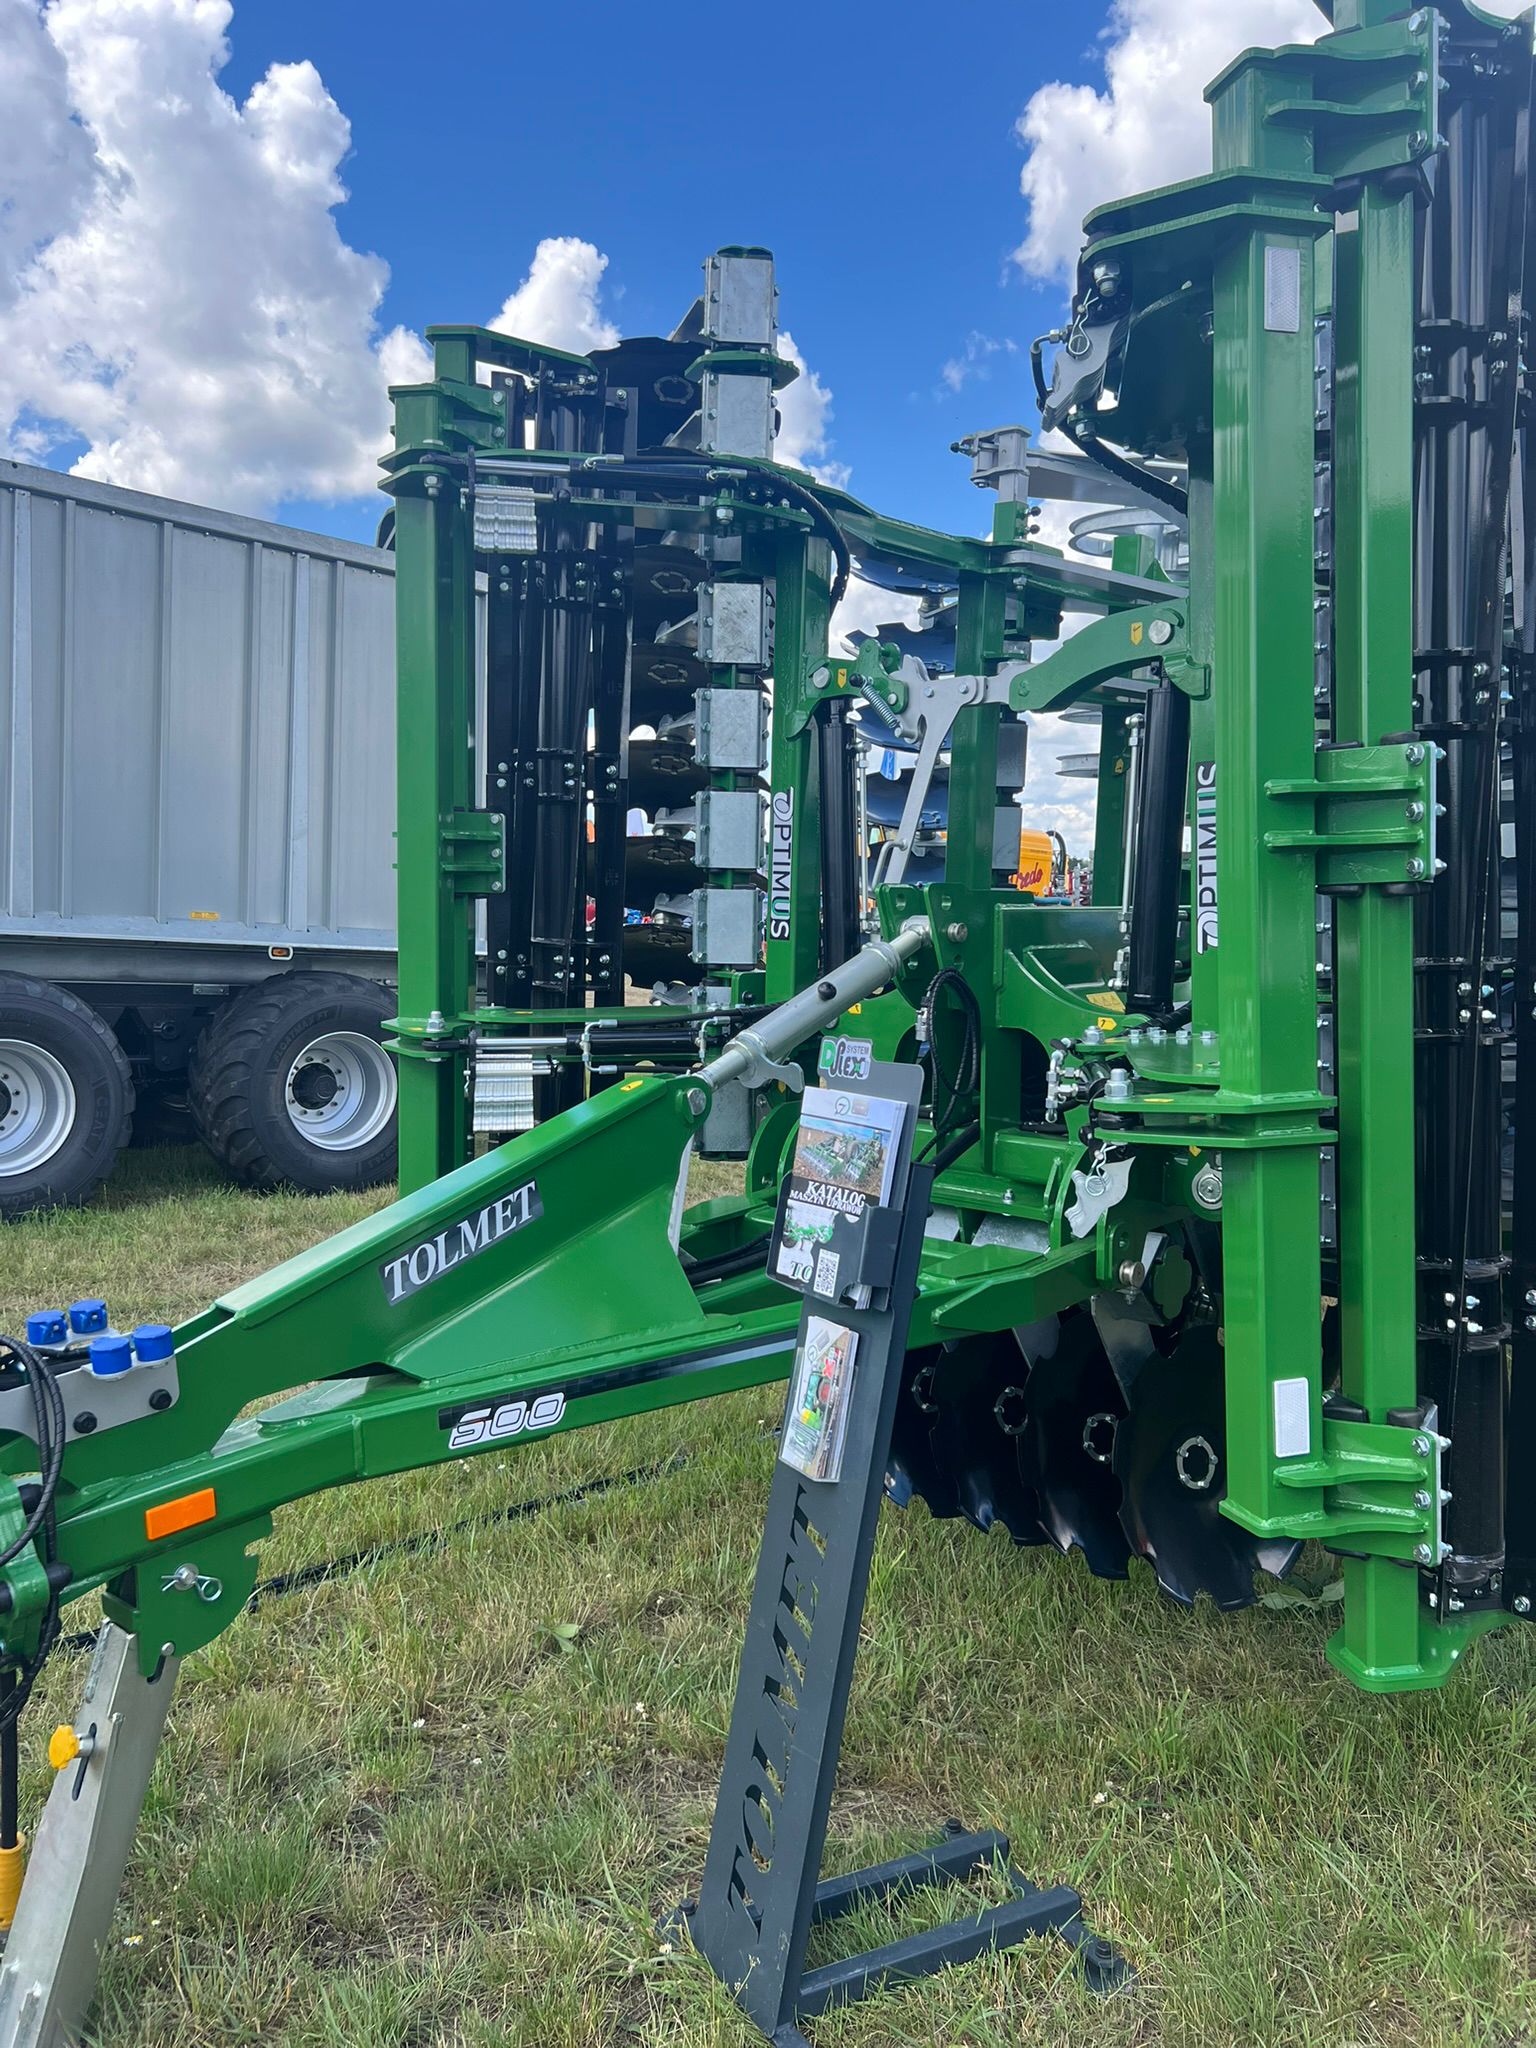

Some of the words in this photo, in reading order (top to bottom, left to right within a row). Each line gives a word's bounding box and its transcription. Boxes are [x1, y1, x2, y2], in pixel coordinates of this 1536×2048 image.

[770, 785, 795, 939] OPTIMUS
[789, 1189, 825, 1206] MASZYN
[804, 1180, 866, 1208] KATALOG
[383, 1180, 536, 1301] TOLMET
[449, 1392, 567, 1449] 500
[726, 1481, 828, 1944] TOLMET
